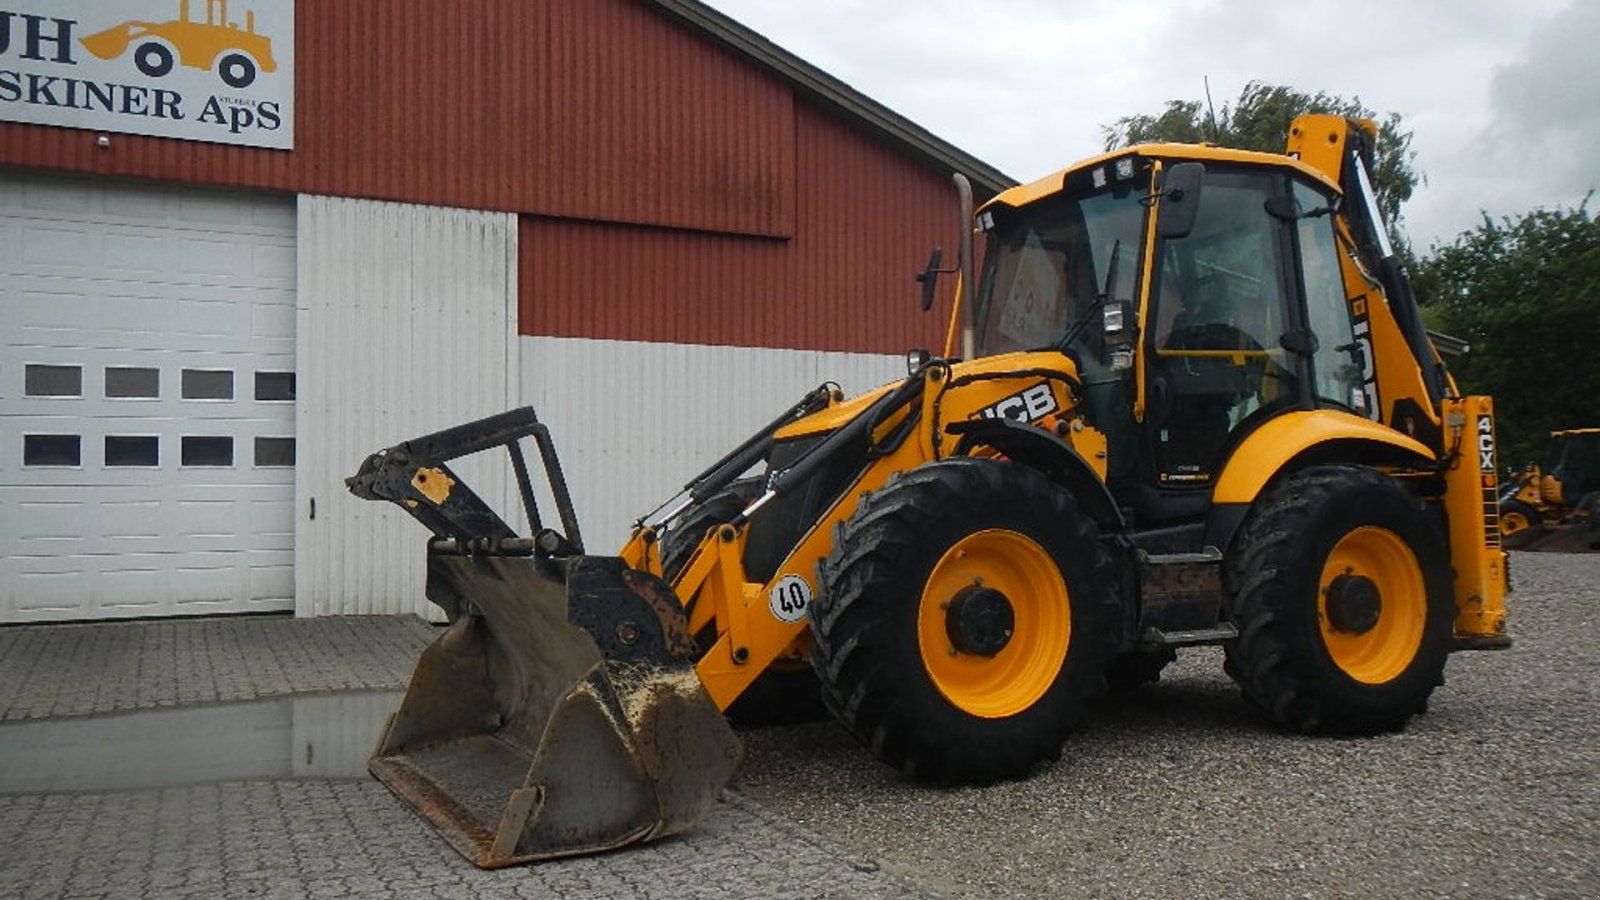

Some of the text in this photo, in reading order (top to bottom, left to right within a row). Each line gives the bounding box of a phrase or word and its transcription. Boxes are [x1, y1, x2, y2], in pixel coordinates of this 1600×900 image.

[0, 70, 281, 134] SKINER ApS
[1478, 416, 1494, 469] 4CX
[779, 582, 806, 613] 40
